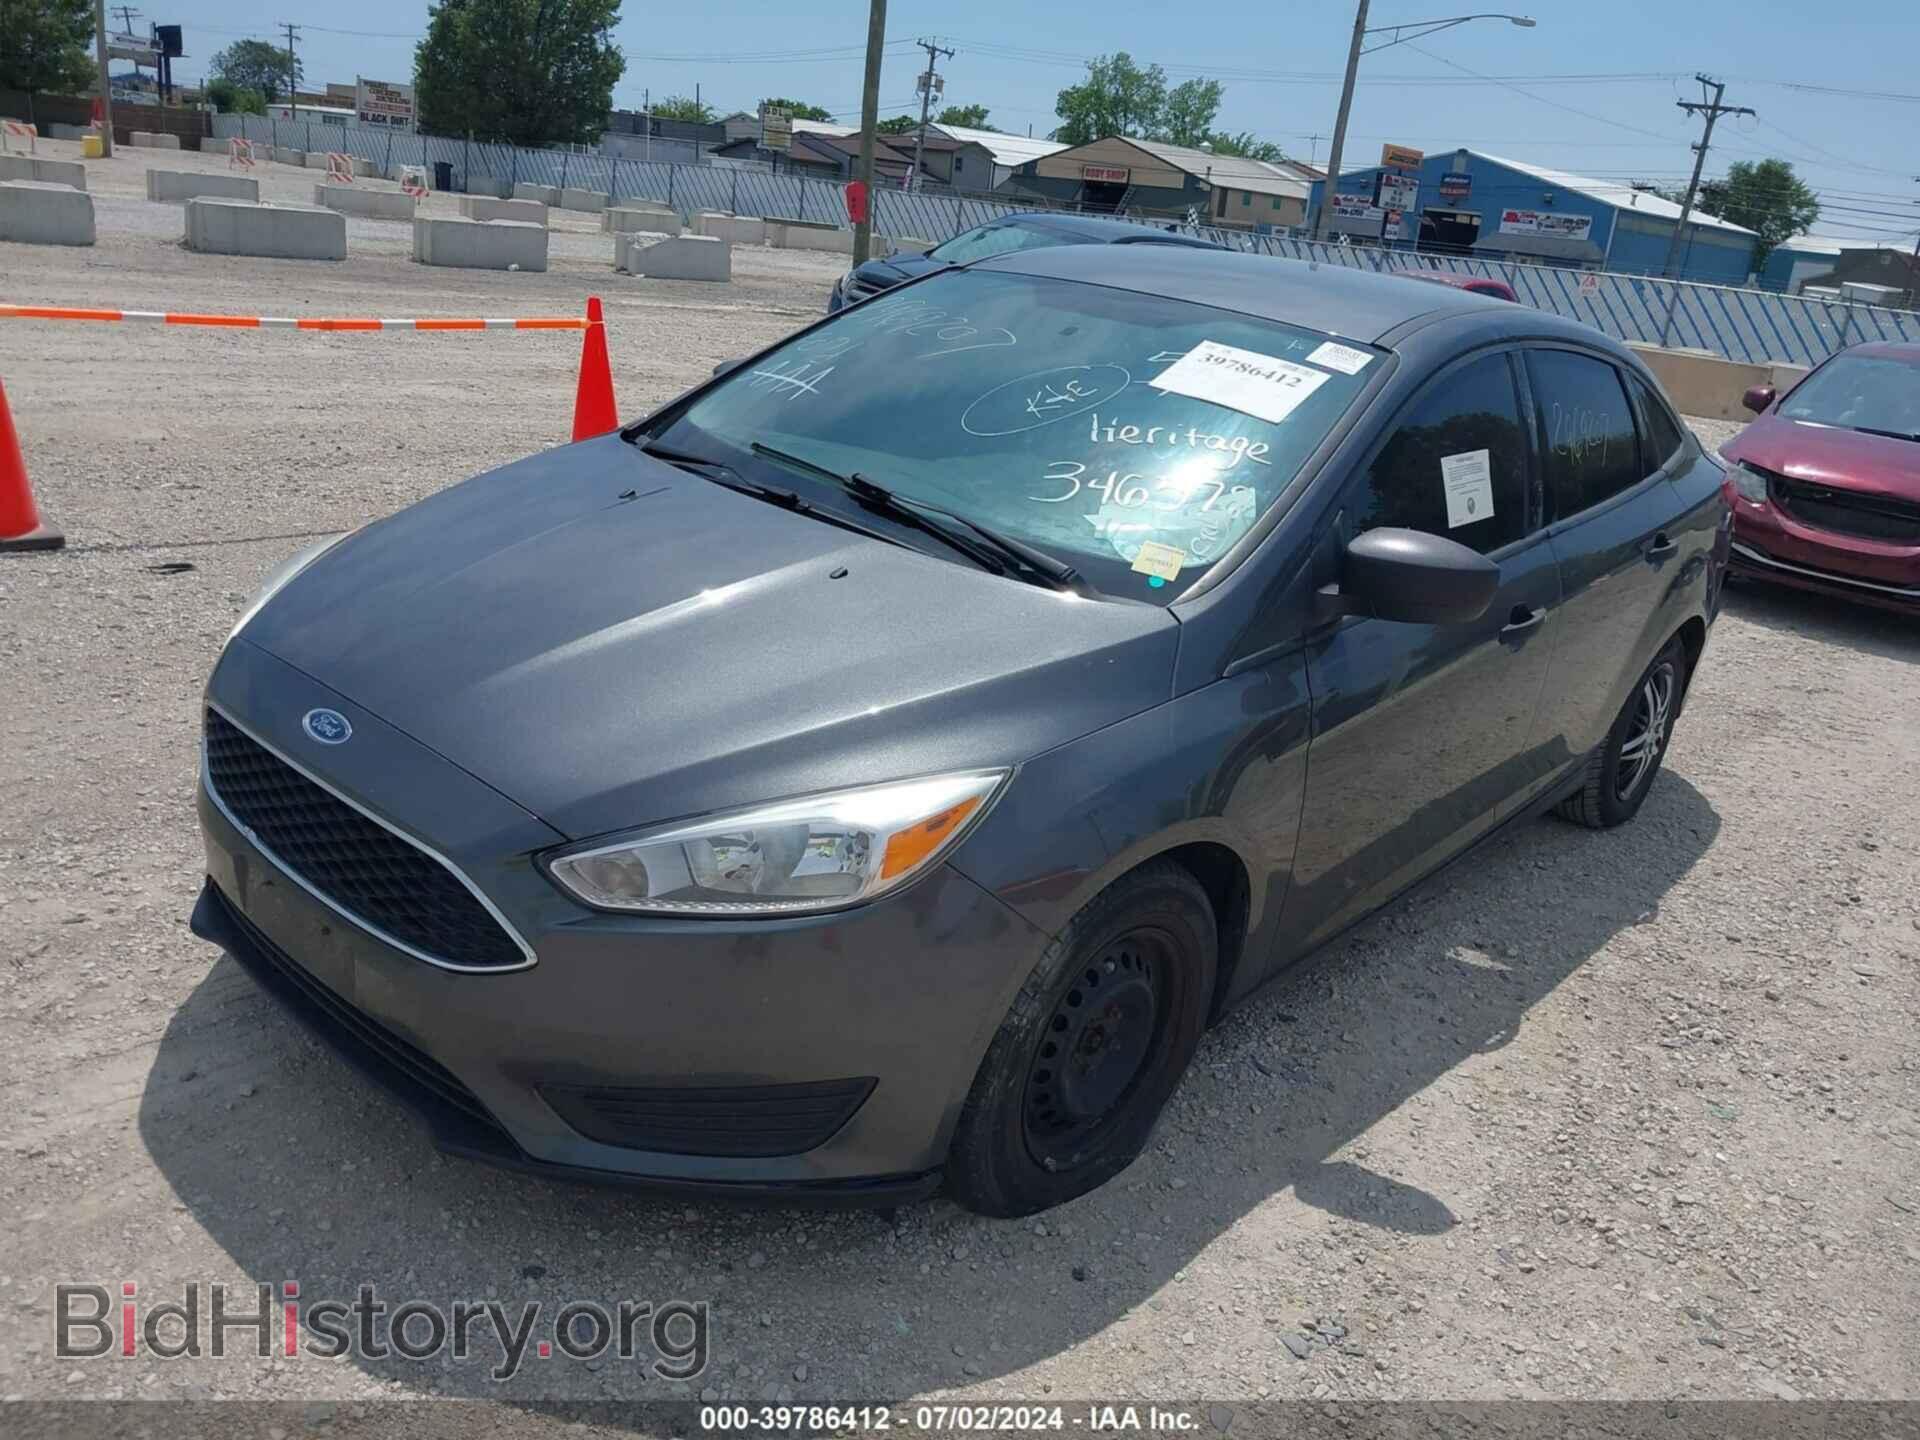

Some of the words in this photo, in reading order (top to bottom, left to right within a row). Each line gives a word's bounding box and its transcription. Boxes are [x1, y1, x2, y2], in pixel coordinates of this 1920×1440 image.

[360, 111, 387, 124] BLACK
[390, 115, 409, 128] DIRT
[1197, 352, 1303, 388] 39786412
